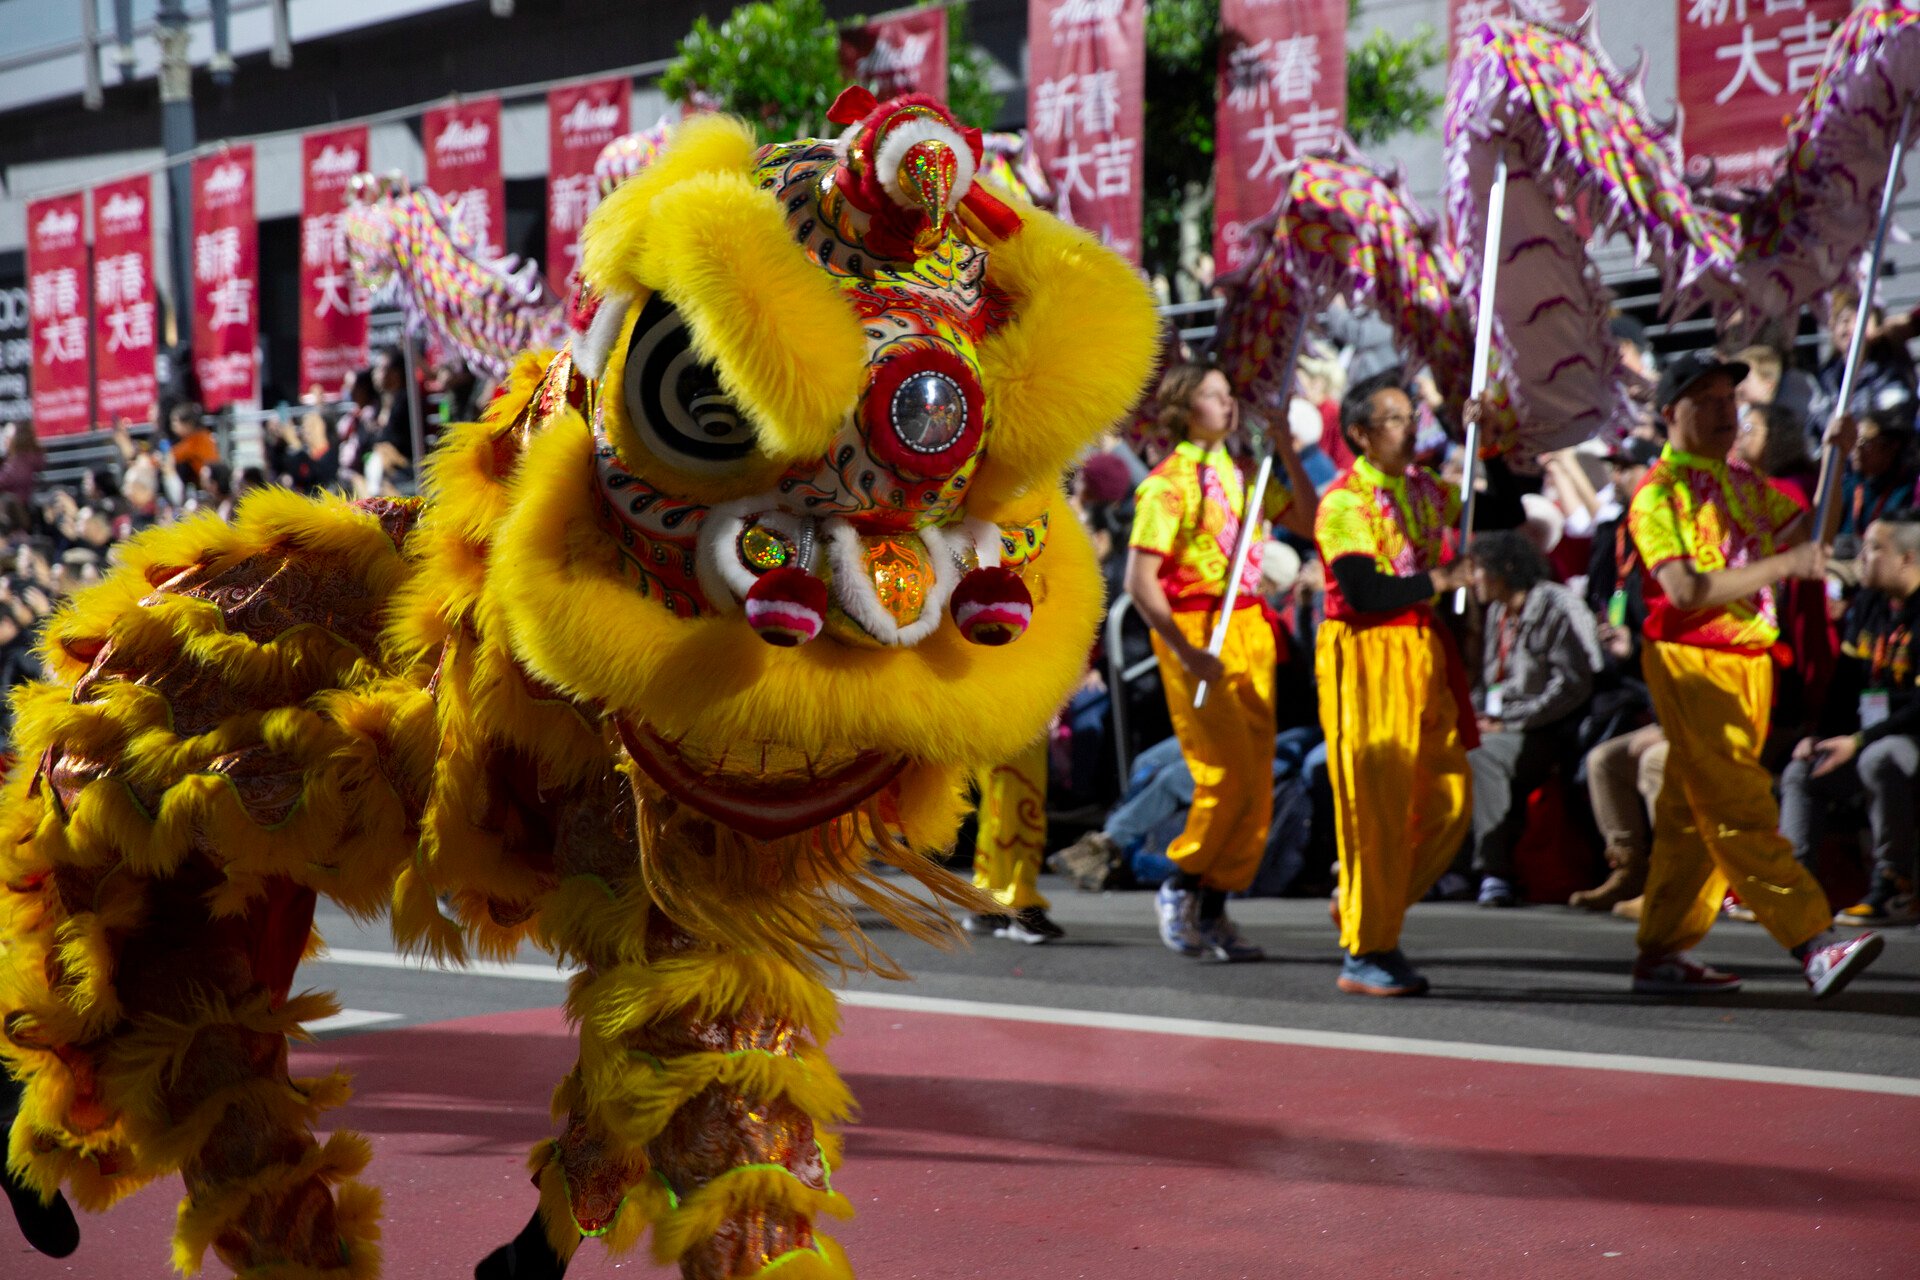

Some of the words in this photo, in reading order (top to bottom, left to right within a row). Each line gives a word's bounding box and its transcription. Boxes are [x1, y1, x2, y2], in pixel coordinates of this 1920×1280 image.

[1226, 34, 1322, 110] 新春
[1034, 70, 1119, 142] 新春
[1050, 136, 1136, 199] 大吉
[107, 303, 154, 351] 大吉
